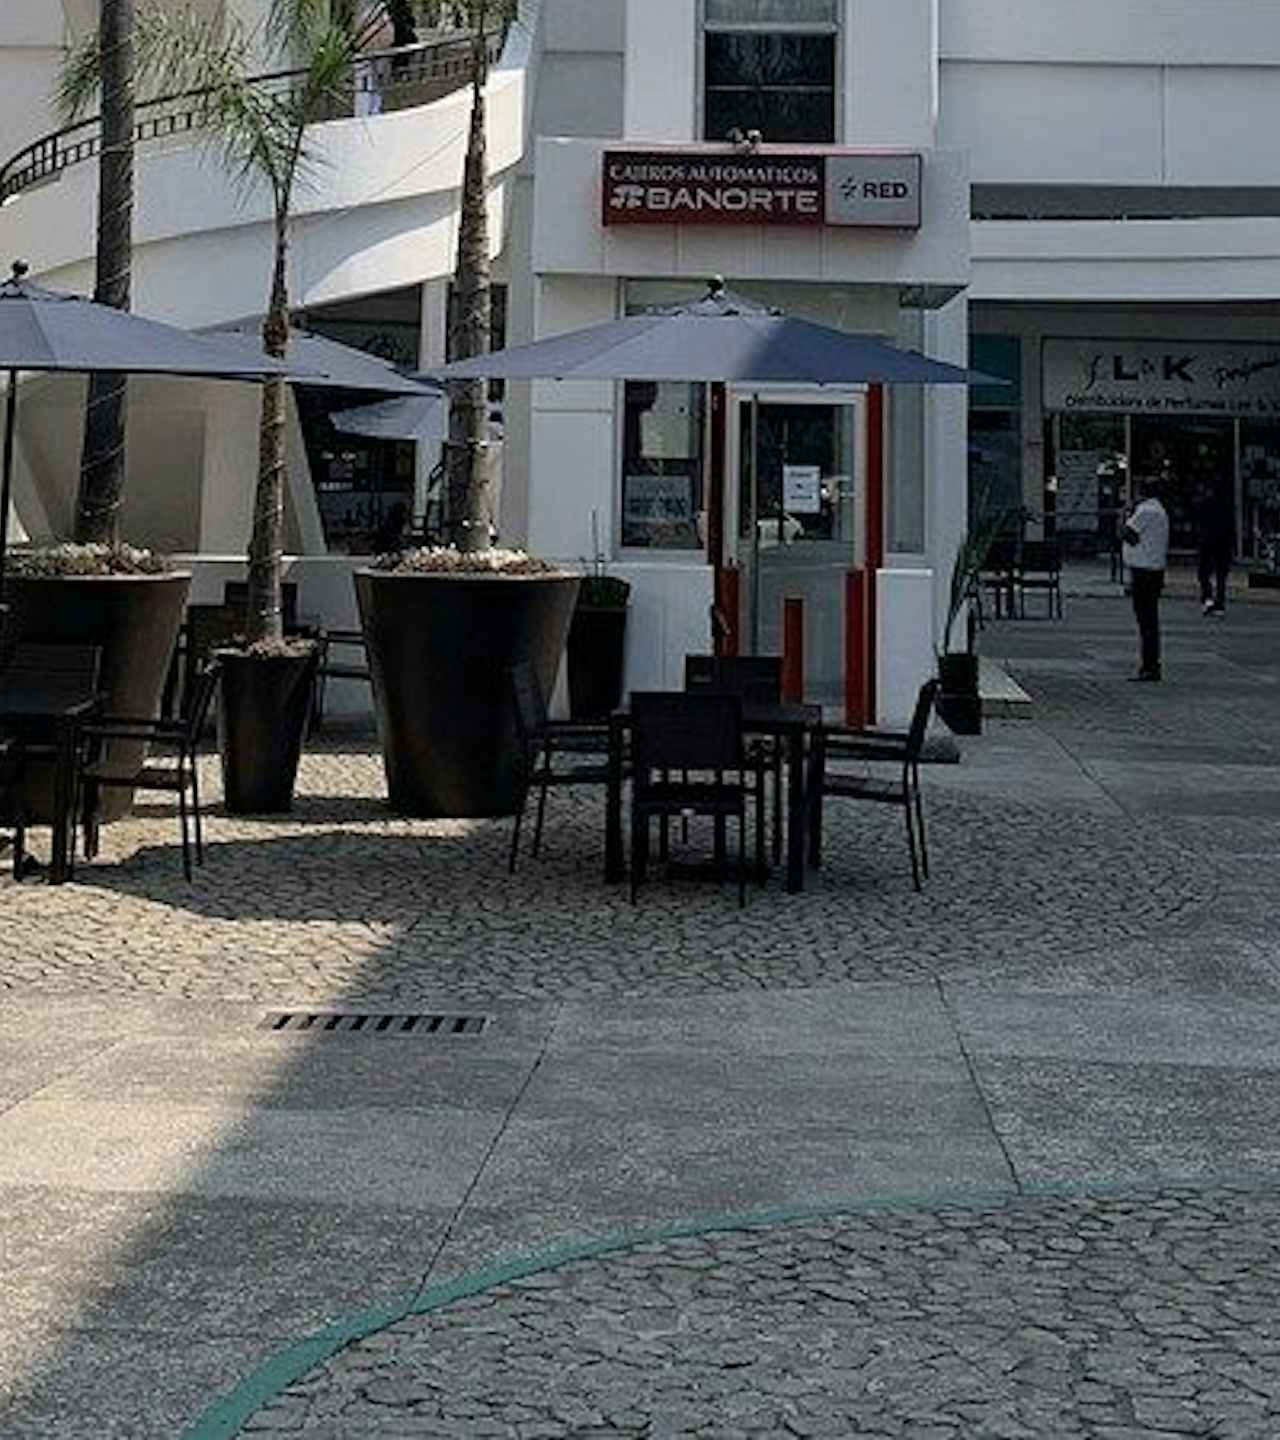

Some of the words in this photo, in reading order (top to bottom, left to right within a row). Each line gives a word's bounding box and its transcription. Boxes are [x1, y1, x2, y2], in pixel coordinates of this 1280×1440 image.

[609, 163, 685, 181] CAJEROS
[863, 182, 908, 199] RED
[646, 187, 818, 213] BANORTE
